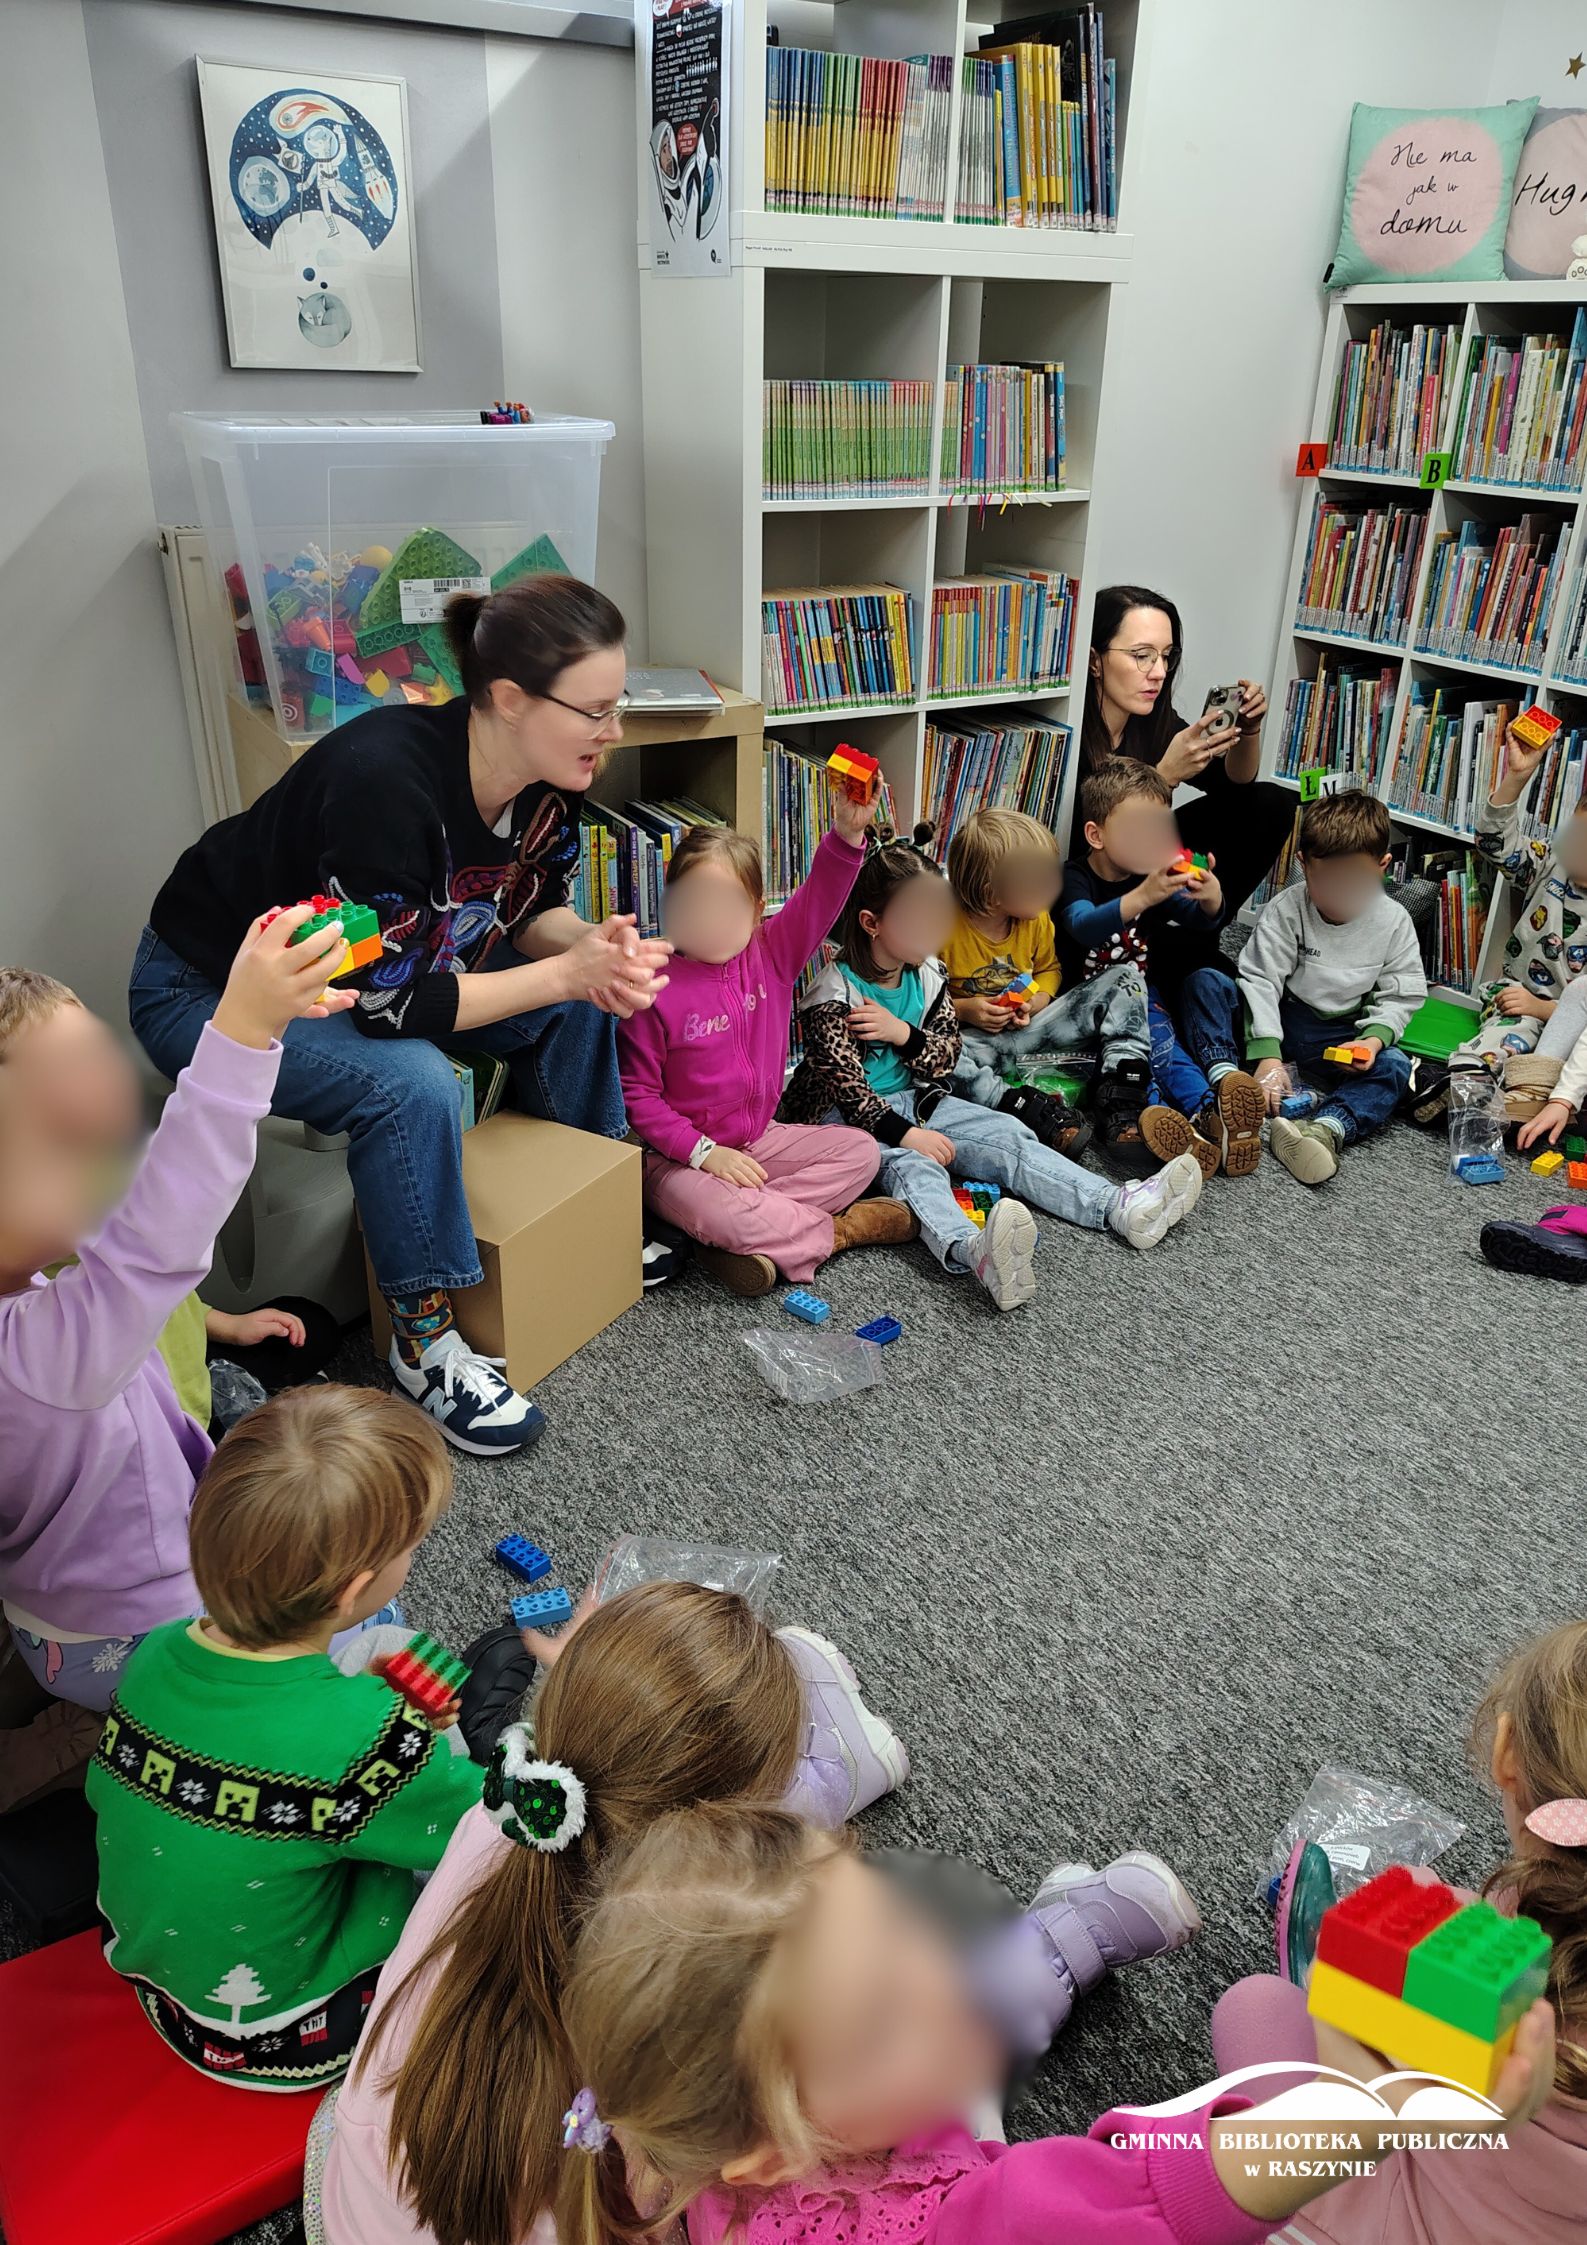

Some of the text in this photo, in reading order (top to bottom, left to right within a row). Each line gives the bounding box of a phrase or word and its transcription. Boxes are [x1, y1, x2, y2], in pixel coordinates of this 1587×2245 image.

[1004, 73, 1012, 127] Dictionary
[1006, 139, 1014, 189] Thesaurus
[1391, 141, 1477, 168] Nie ma
[1405, 175, 1460, 206] jak w
[1380, 208, 1467, 235] domu
[1301, 450, 1315, 470] A
[1426, 459, 1442, 484] B
[1305, 775, 1317, 797] Ł
[609, 886, 618, 909] SNOW
[421, 1386, 458, 1424] N
